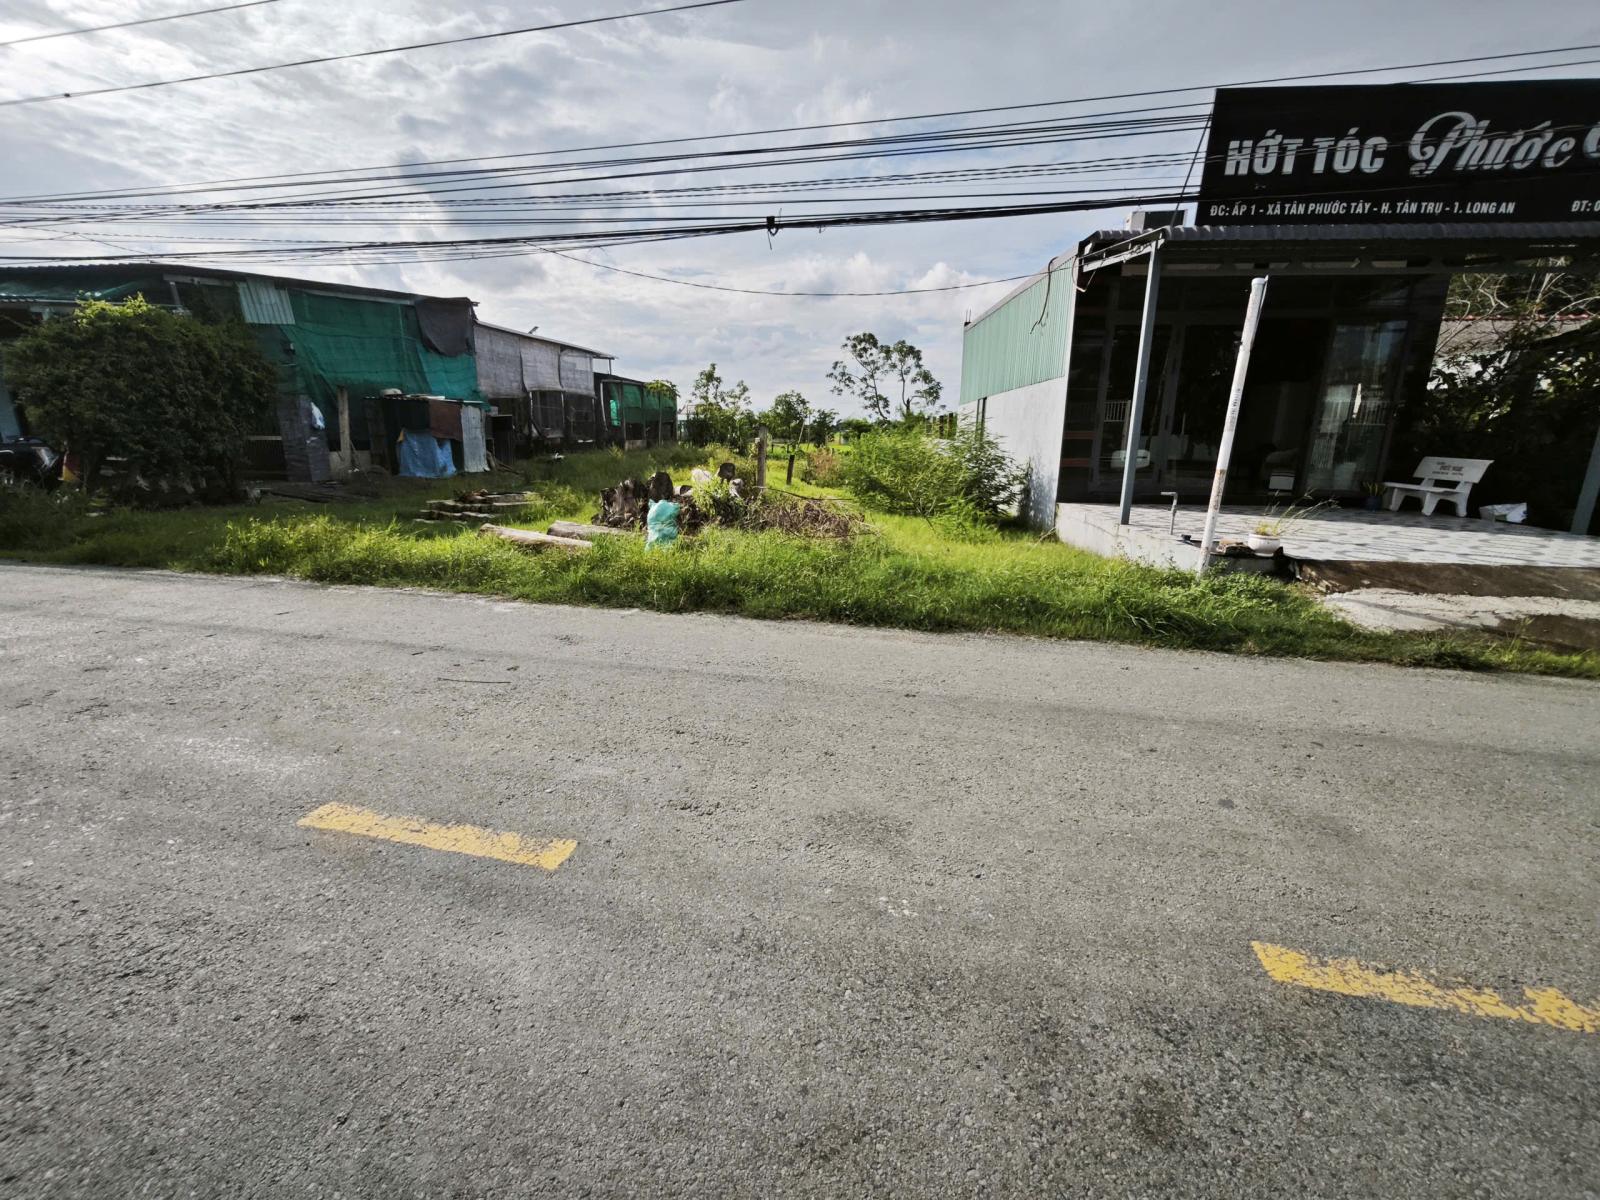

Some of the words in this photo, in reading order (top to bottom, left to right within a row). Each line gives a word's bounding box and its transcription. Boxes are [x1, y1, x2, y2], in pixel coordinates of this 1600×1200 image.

[1224, 129, 1304, 175] HỚT
[1312, 127, 1388, 174] TÓC
[1408, 111, 1576, 177] Phước
[1210, 204, 1230, 216] ĐC:
[1232, 201, 1248, 216] ẤP
[1250, 204, 1256, 216] 1
[1266, 201, 1281, 216] XÃ
[1284, 200, 1306, 215] TÂN
[1308, 200, 1347, 215] PHƯỚC
[1350, 200, 1372, 214] TÂY
[1381, 202, 1392, 214] H.
[1396, 200, 1418, 214] TÂN
[1420, 202, 1443, 216] TRỤ
[1465, 202, 1497, 214] LONG
[1498, 202, 1516, 214] AN
[1571, 199, 1592, 212] ĐT:
